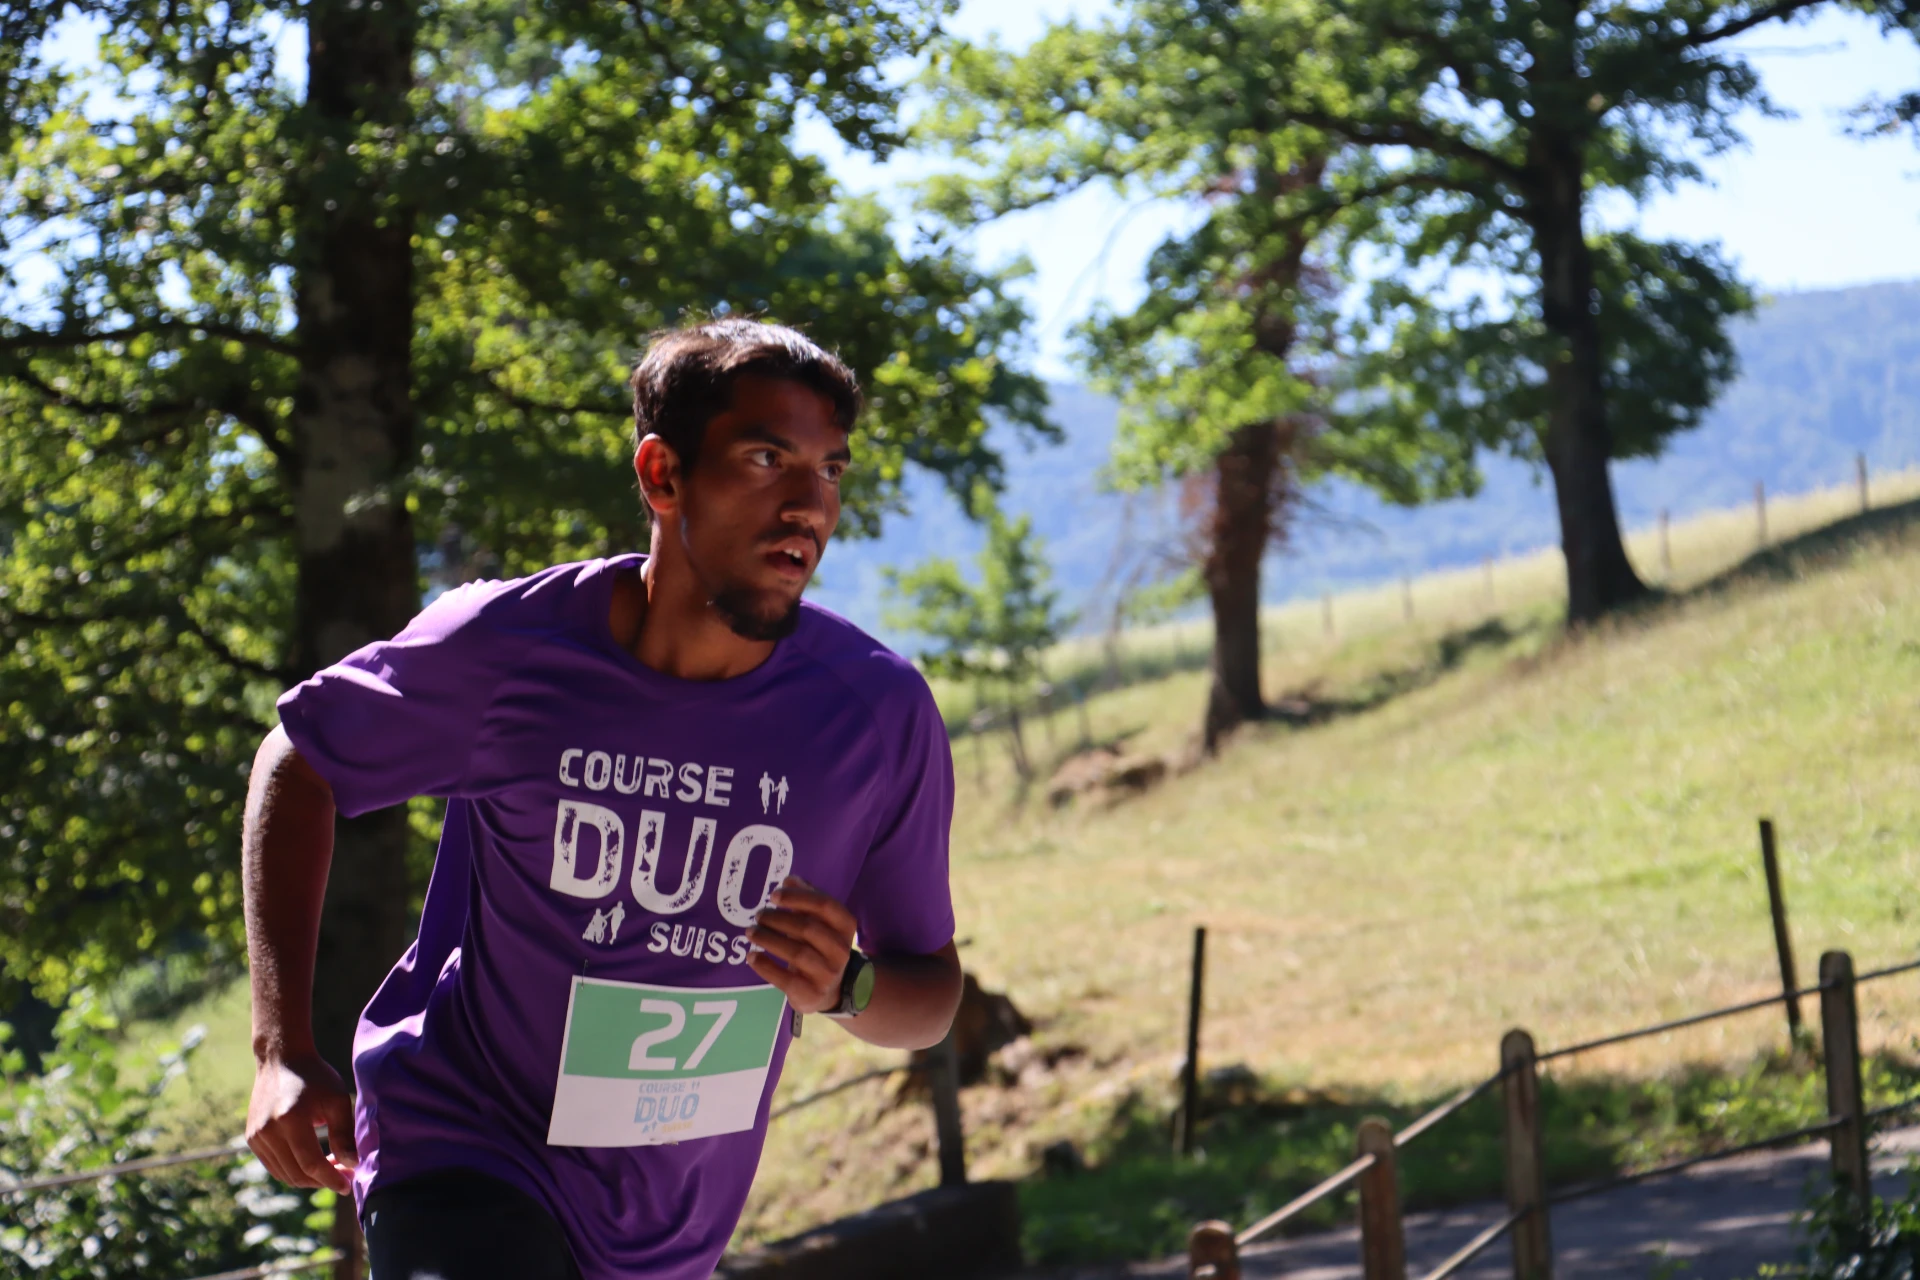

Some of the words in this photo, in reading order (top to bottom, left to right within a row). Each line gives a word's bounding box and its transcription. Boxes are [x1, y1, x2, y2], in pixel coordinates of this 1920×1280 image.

[559, 748, 734, 807] COURSE
[550, 799, 794, 928] DUO
[647, 921, 766, 966] SUISS
[628, 998, 738, 1071] 27
[634, 1093, 700, 1123] DUO
[639, 1081, 686, 1094] COURSE
